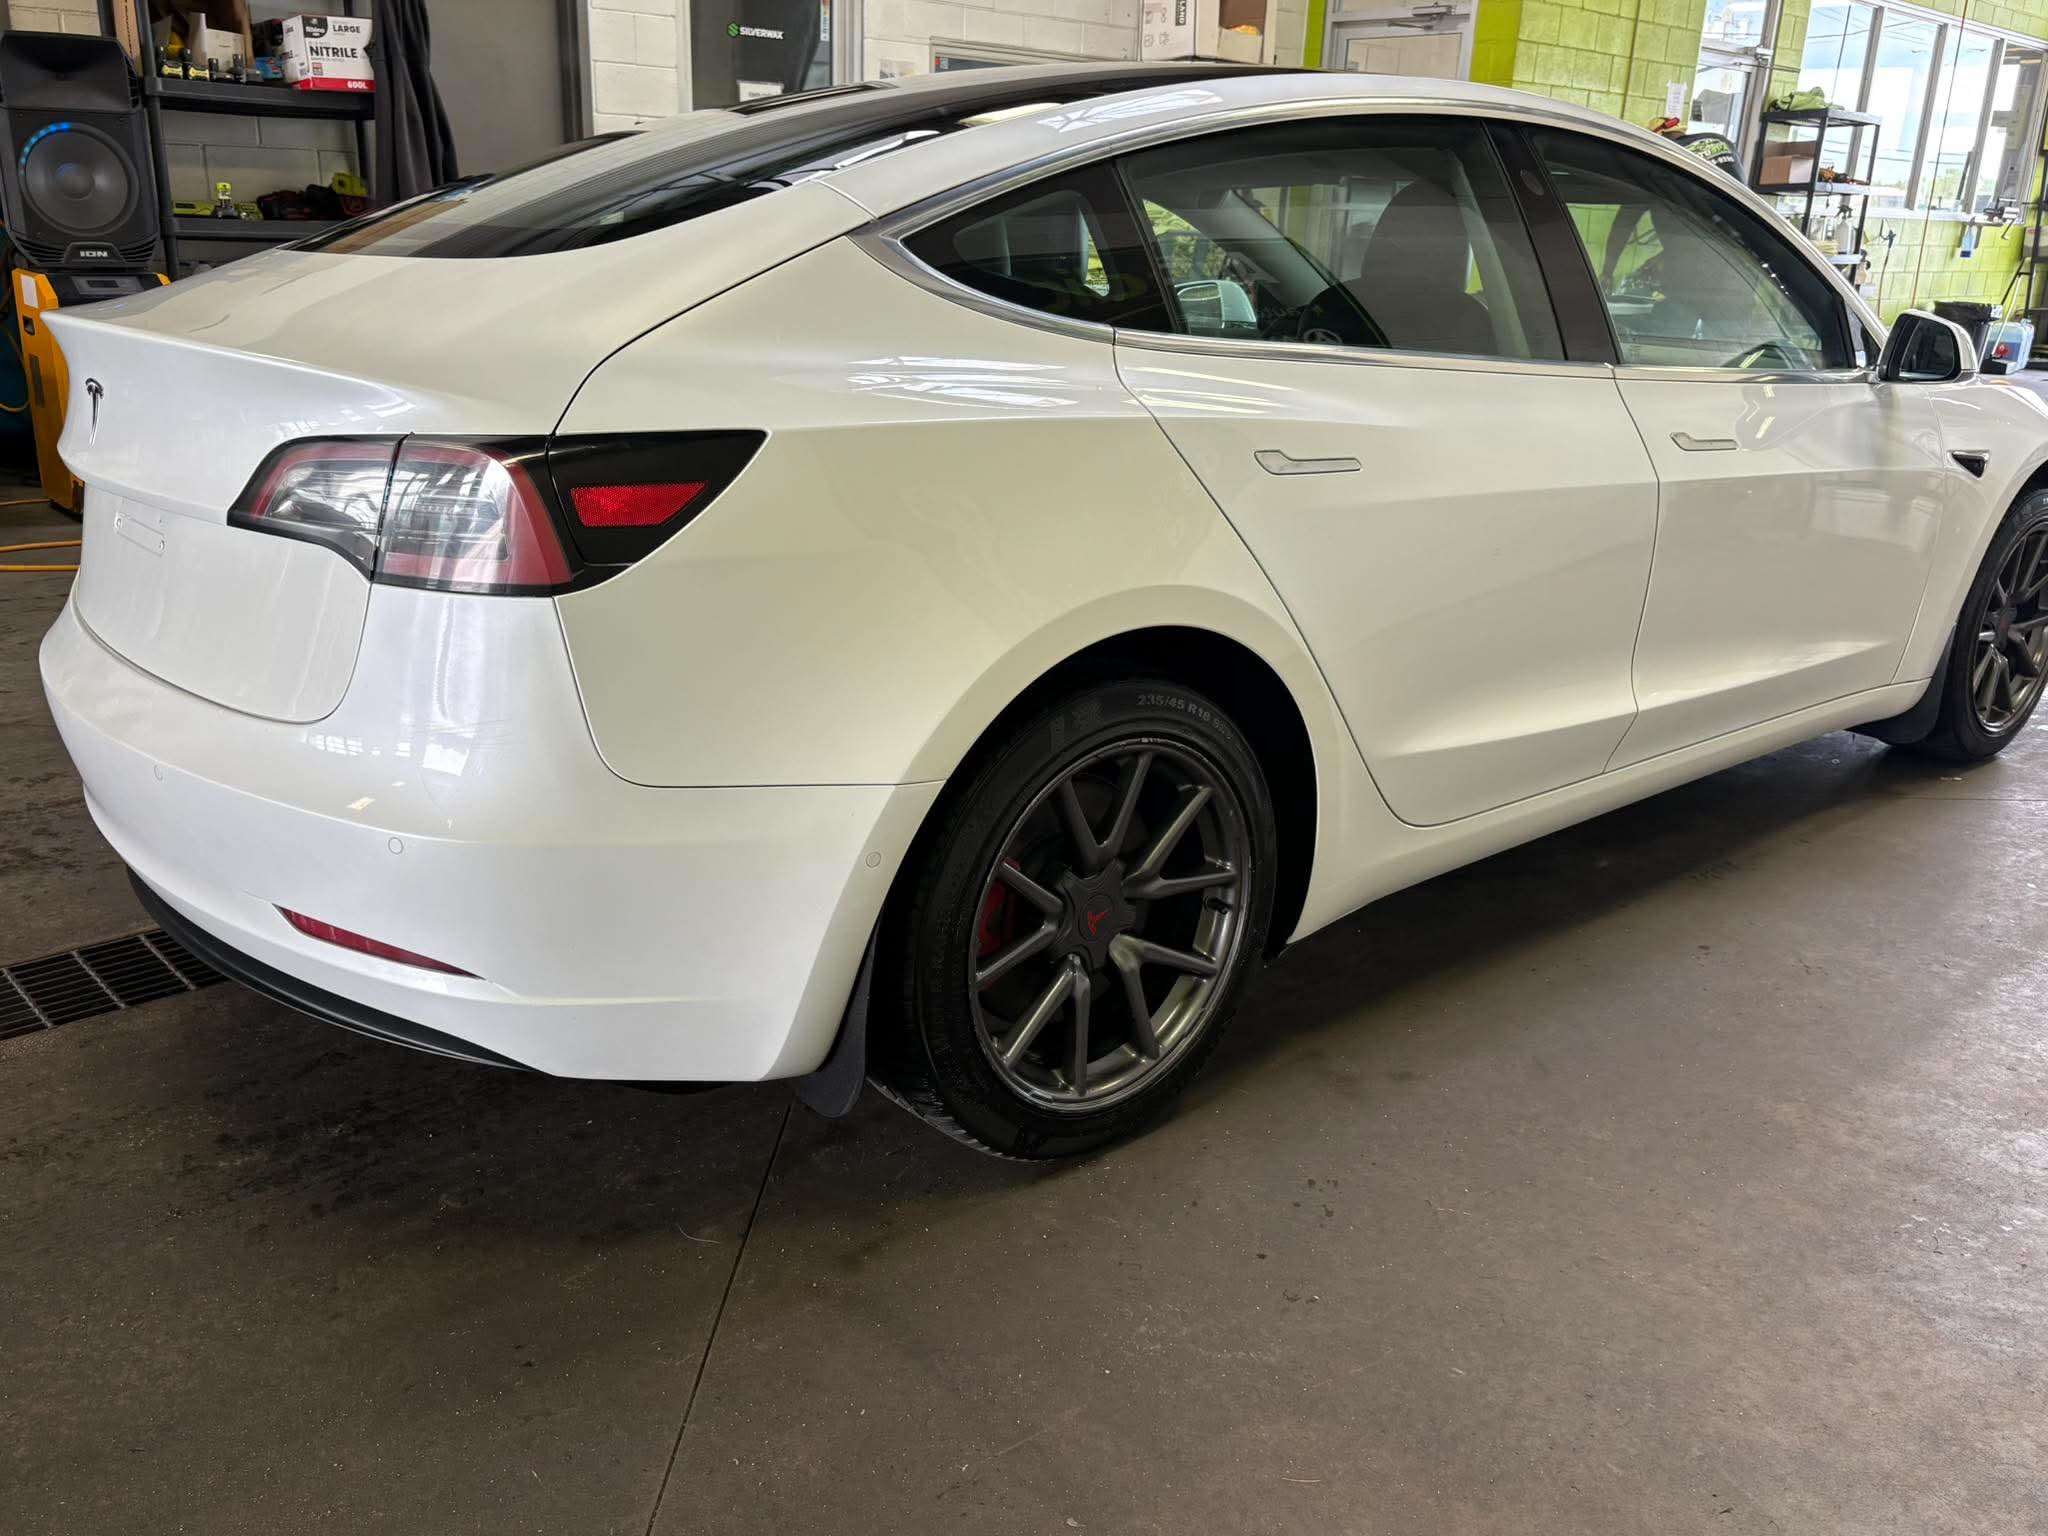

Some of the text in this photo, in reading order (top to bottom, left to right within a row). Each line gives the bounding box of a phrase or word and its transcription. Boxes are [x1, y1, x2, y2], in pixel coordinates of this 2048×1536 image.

[333, 25, 361, 33] LARGE
[740, 26, 784, 40] SILVERWAX
[309, 46, 358, 58] NITRILE
